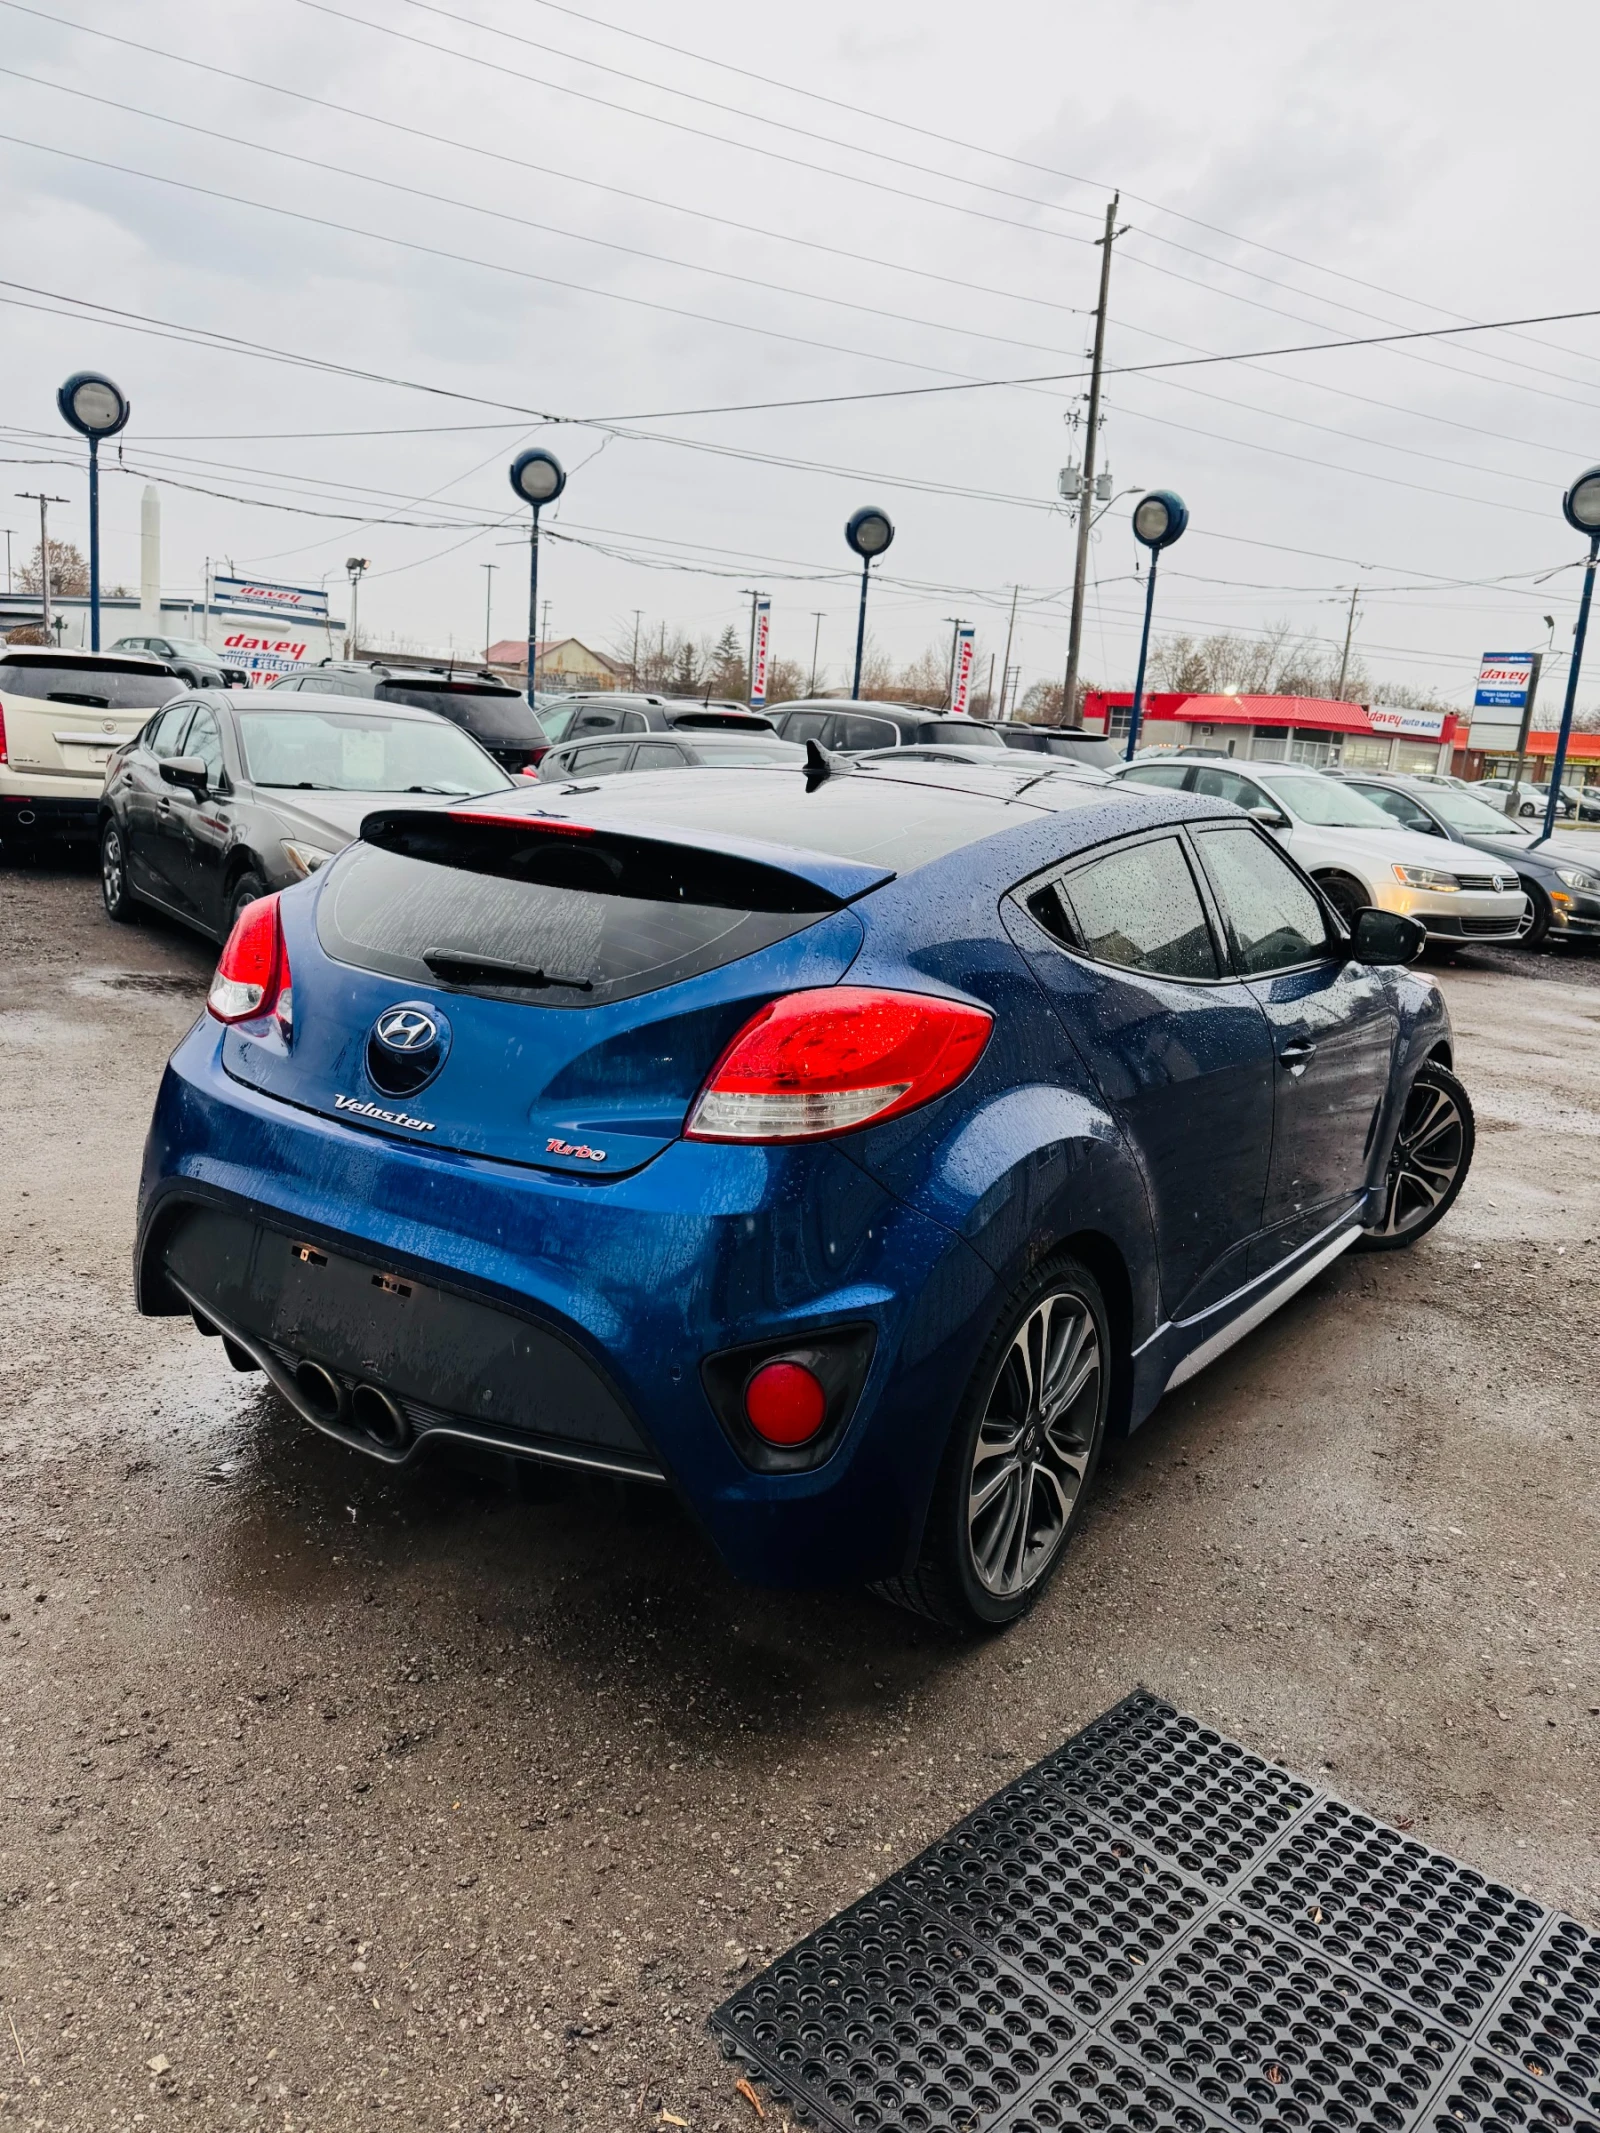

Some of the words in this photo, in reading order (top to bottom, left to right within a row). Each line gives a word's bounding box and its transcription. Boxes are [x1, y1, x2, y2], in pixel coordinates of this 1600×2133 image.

[240, 587, 302, 603] davey
[224, 634, 307, 660] davey
[754, 616, 768, 694] davey
[225, 656, 254, 668] HUGE
[256, 658, 311, 671] SELECTION
[953, 642, 973, 713] davey
[1480, 668, 1529, 685] davey
[1369, 710, 1402, 727] davey
[1401, 718, 1420, 727] auto
[1420, 720, 1441, 729] sales
[334, 1093, 436, 1131] Veloster
[545, 1137, 607, 1162] Turbo
